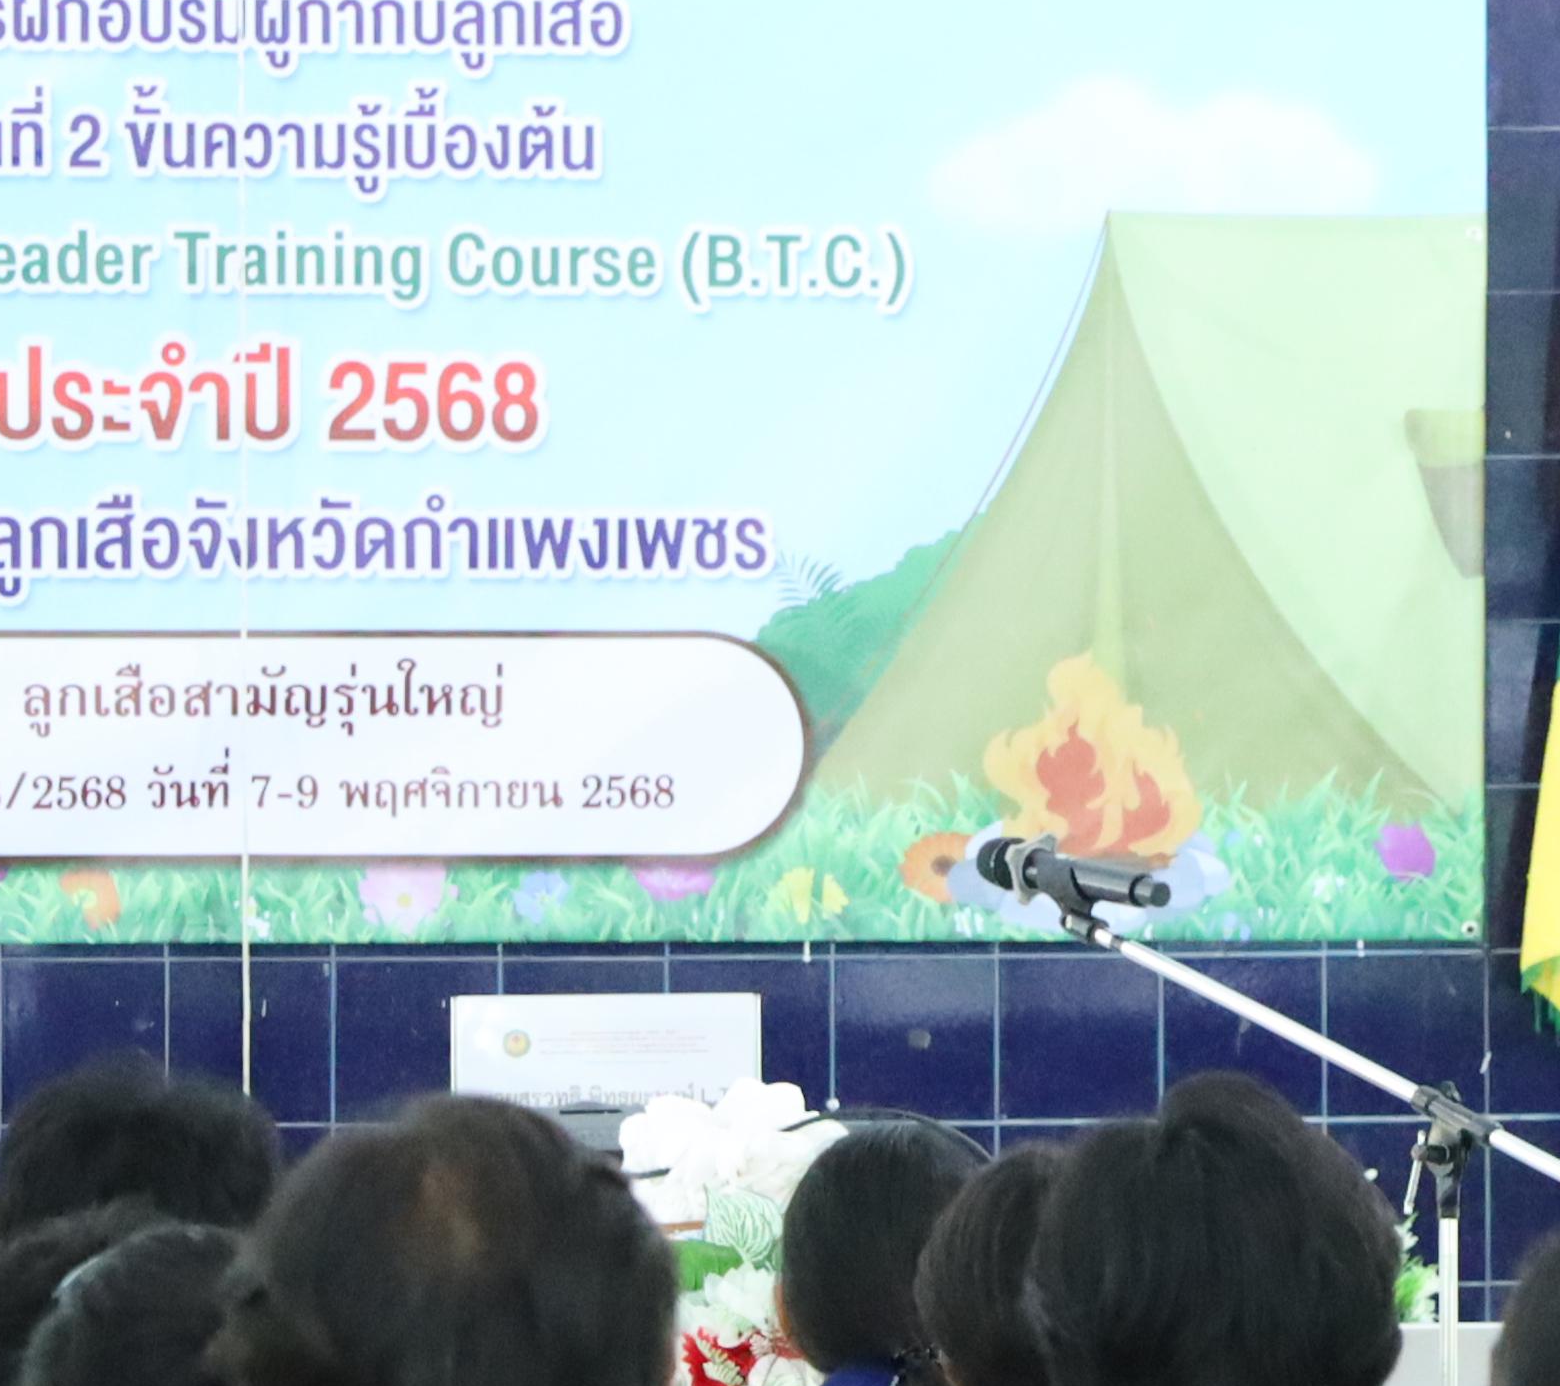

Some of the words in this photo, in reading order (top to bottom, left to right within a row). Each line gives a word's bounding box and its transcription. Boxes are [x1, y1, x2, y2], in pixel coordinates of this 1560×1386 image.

[68, 113, 102, 169] 2
[125, 84, 597, 195] ขั้นความรู้เบื้องต้น
[174, 229, 422, 302] Training
[448, 231, 656, 289] Course
[682, 231, 907, 305] (B.T.C.)
[328, 361, 539, 444] 2568
[23, 657, 505, 737] ลูกเสือสามัญรุ่นใหญ่
[147, 747, 231, 810] วันที่
[250, 774, 319, 809] 7-9
[338, 766, 564, 816] พฤศจิกายน
[581, 775, 675, 809] 2568
